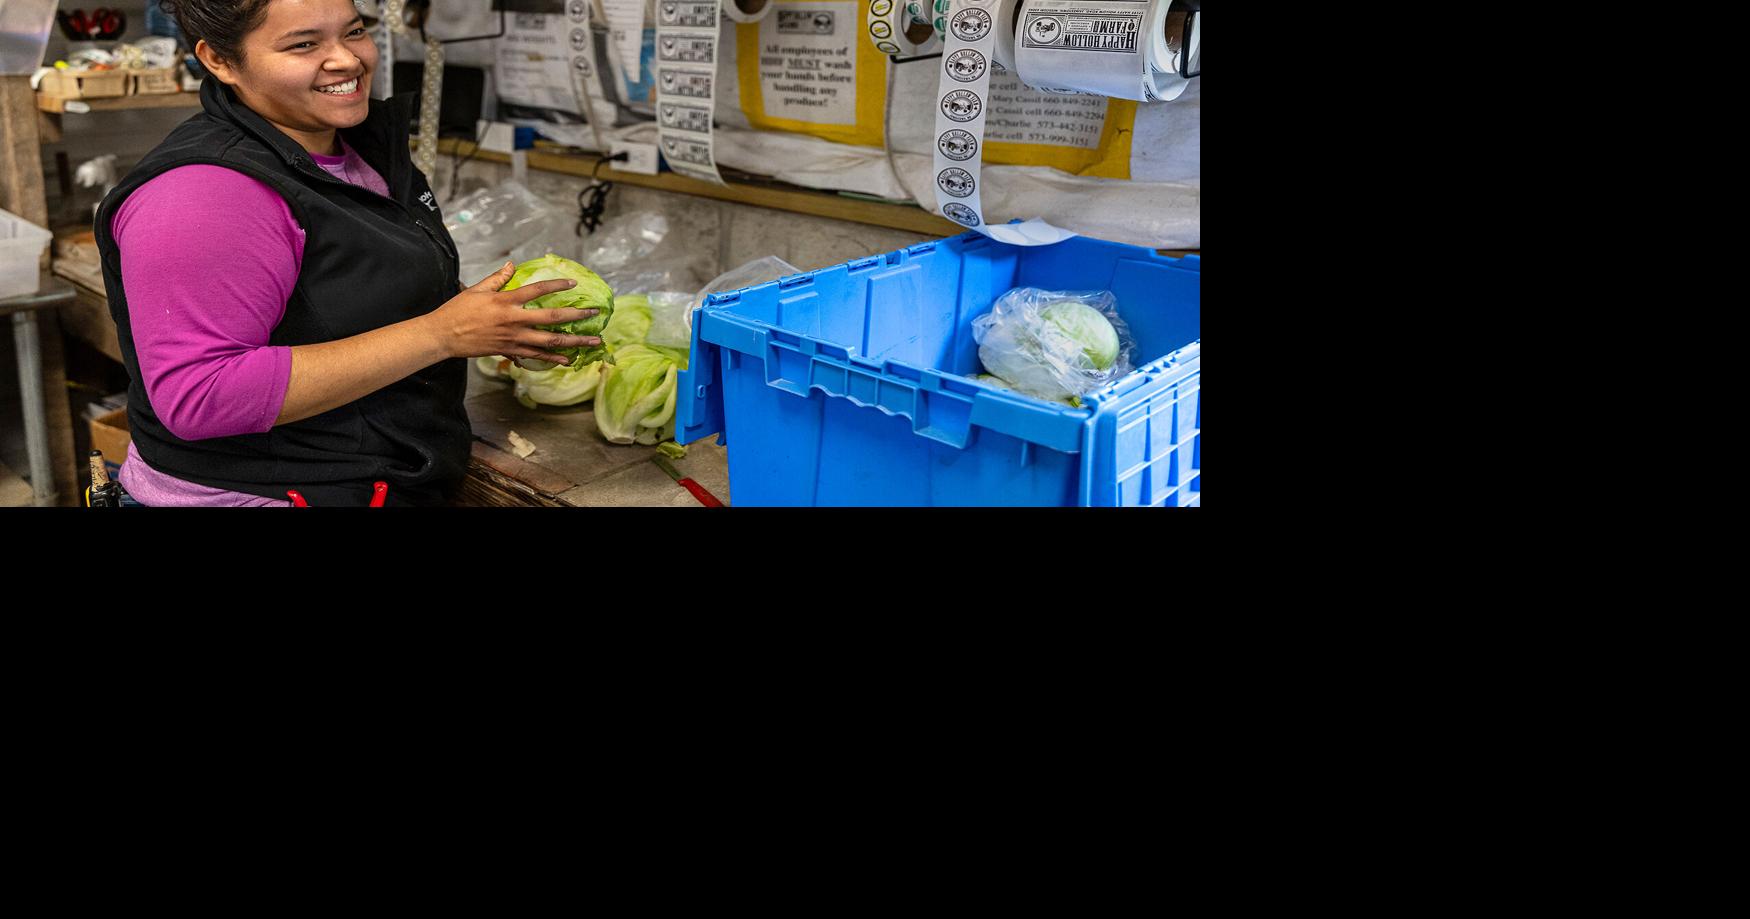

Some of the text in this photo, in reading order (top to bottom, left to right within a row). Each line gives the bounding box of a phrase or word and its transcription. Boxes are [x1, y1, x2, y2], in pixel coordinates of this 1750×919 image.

[1063, 31, 1136, 49] HAPPY HOLLOW
[767, 45, 849, 57] All employees of
[787, 58, 821, 69] MUST
[824, 61, 852, 69] wash
[761, 71, 852, 82] your hands before
[773, 83, 837, 97] handling any
[999, 82, 1017, 90] cell
[784, 97, 828, 107] produce!
[992, 95, 1013, 104] Mary
[1025, 108, 1042, 116] cell
[1006, 132, 1023, 140] cell
